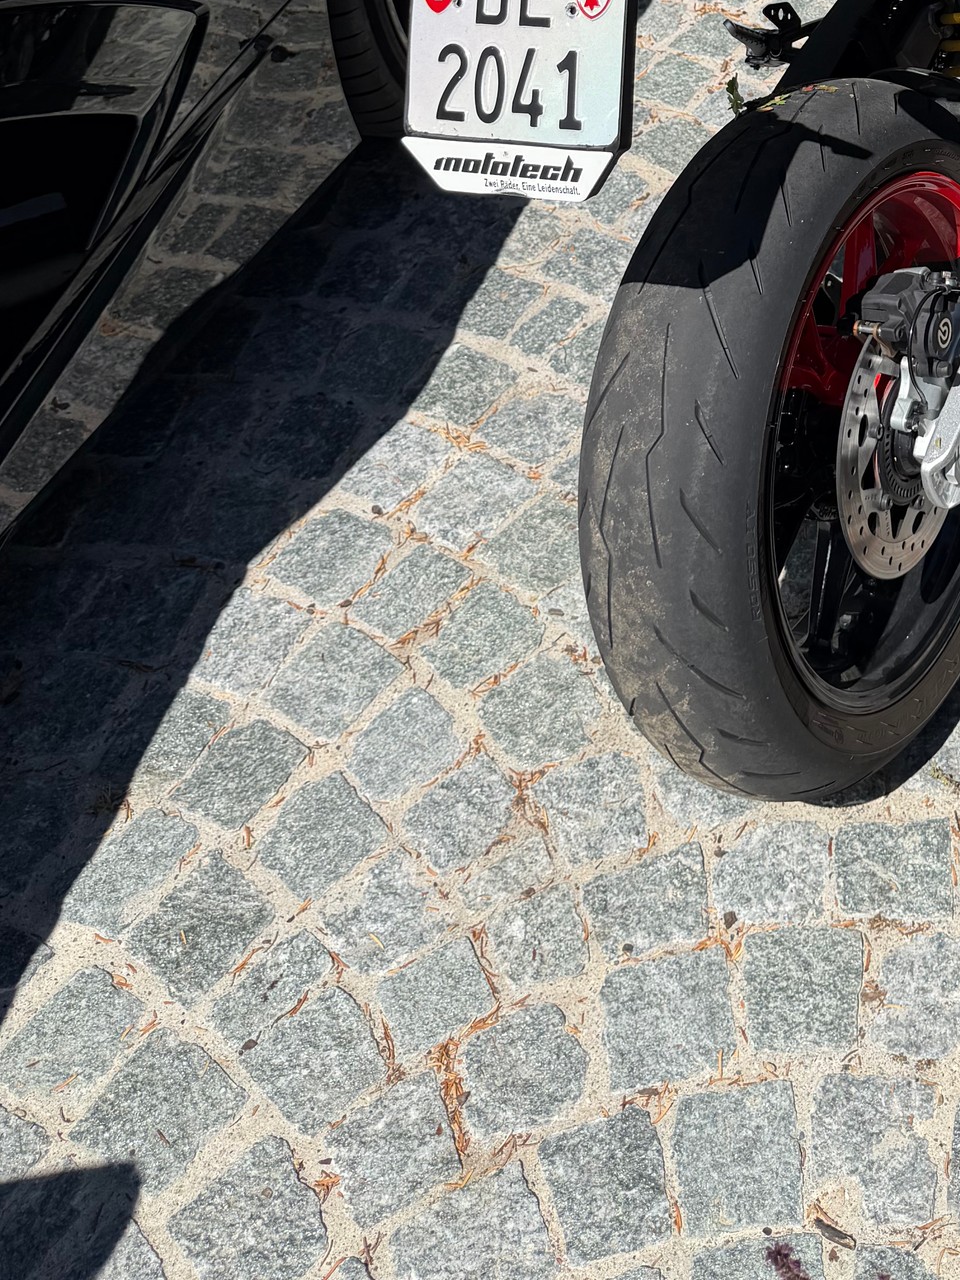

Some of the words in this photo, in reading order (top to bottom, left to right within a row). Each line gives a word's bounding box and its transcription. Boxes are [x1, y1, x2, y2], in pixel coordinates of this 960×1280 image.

[436, 43, 582, 130] 2041
[433, 152, 583, 182] mototech
[484, 178, 499, 188] Zwei
[522, 182, 536, 191] Eine
[537, 183, 580, 195] Leidenschaft.
